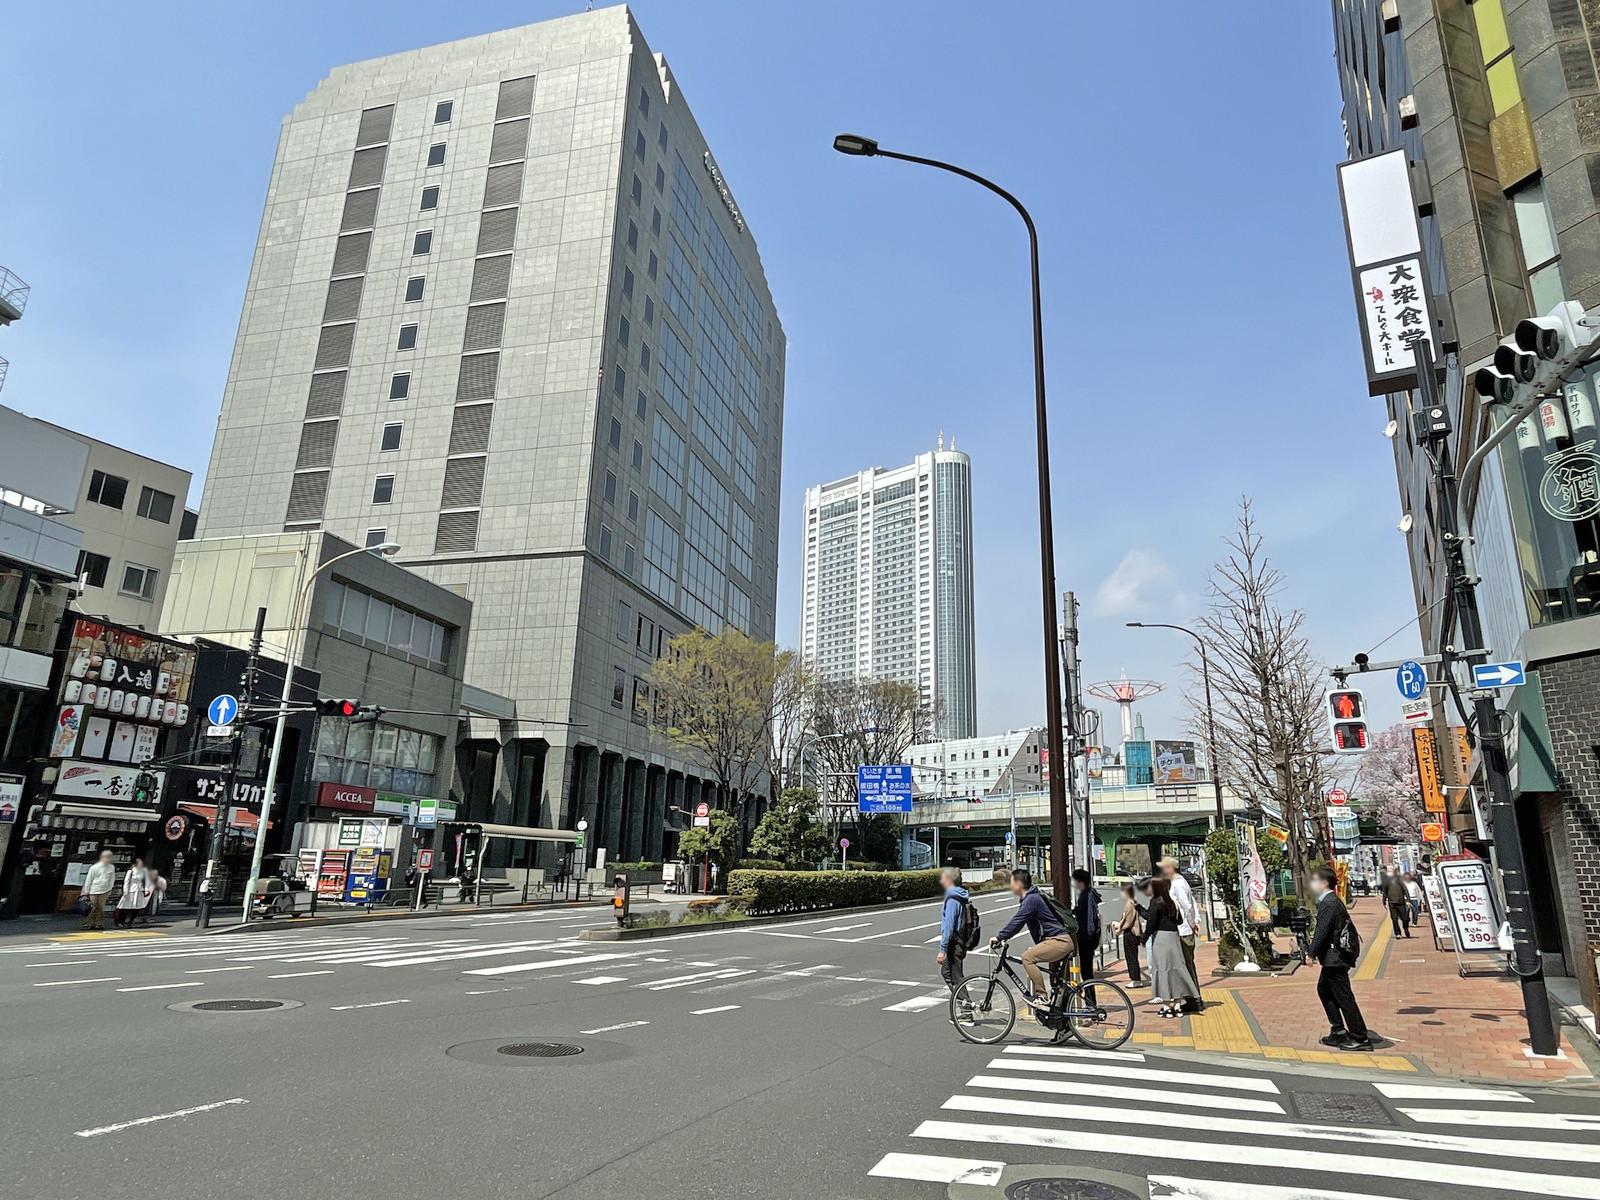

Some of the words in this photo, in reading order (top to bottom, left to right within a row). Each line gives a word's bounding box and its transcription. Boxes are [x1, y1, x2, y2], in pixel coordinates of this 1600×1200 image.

[1388, 264, 1427, 352] 大衆食堂
[1374, 305, 1395, 366] てんぐ大ホール
[1540, 404, 1556, 428] 酒場
[118, 665, 153, 690] 入魂
[1401, 670, 1414, 695] P
[1412, 681, 1420, 693] 60
[334, 791, 363, 804] ACCEA
